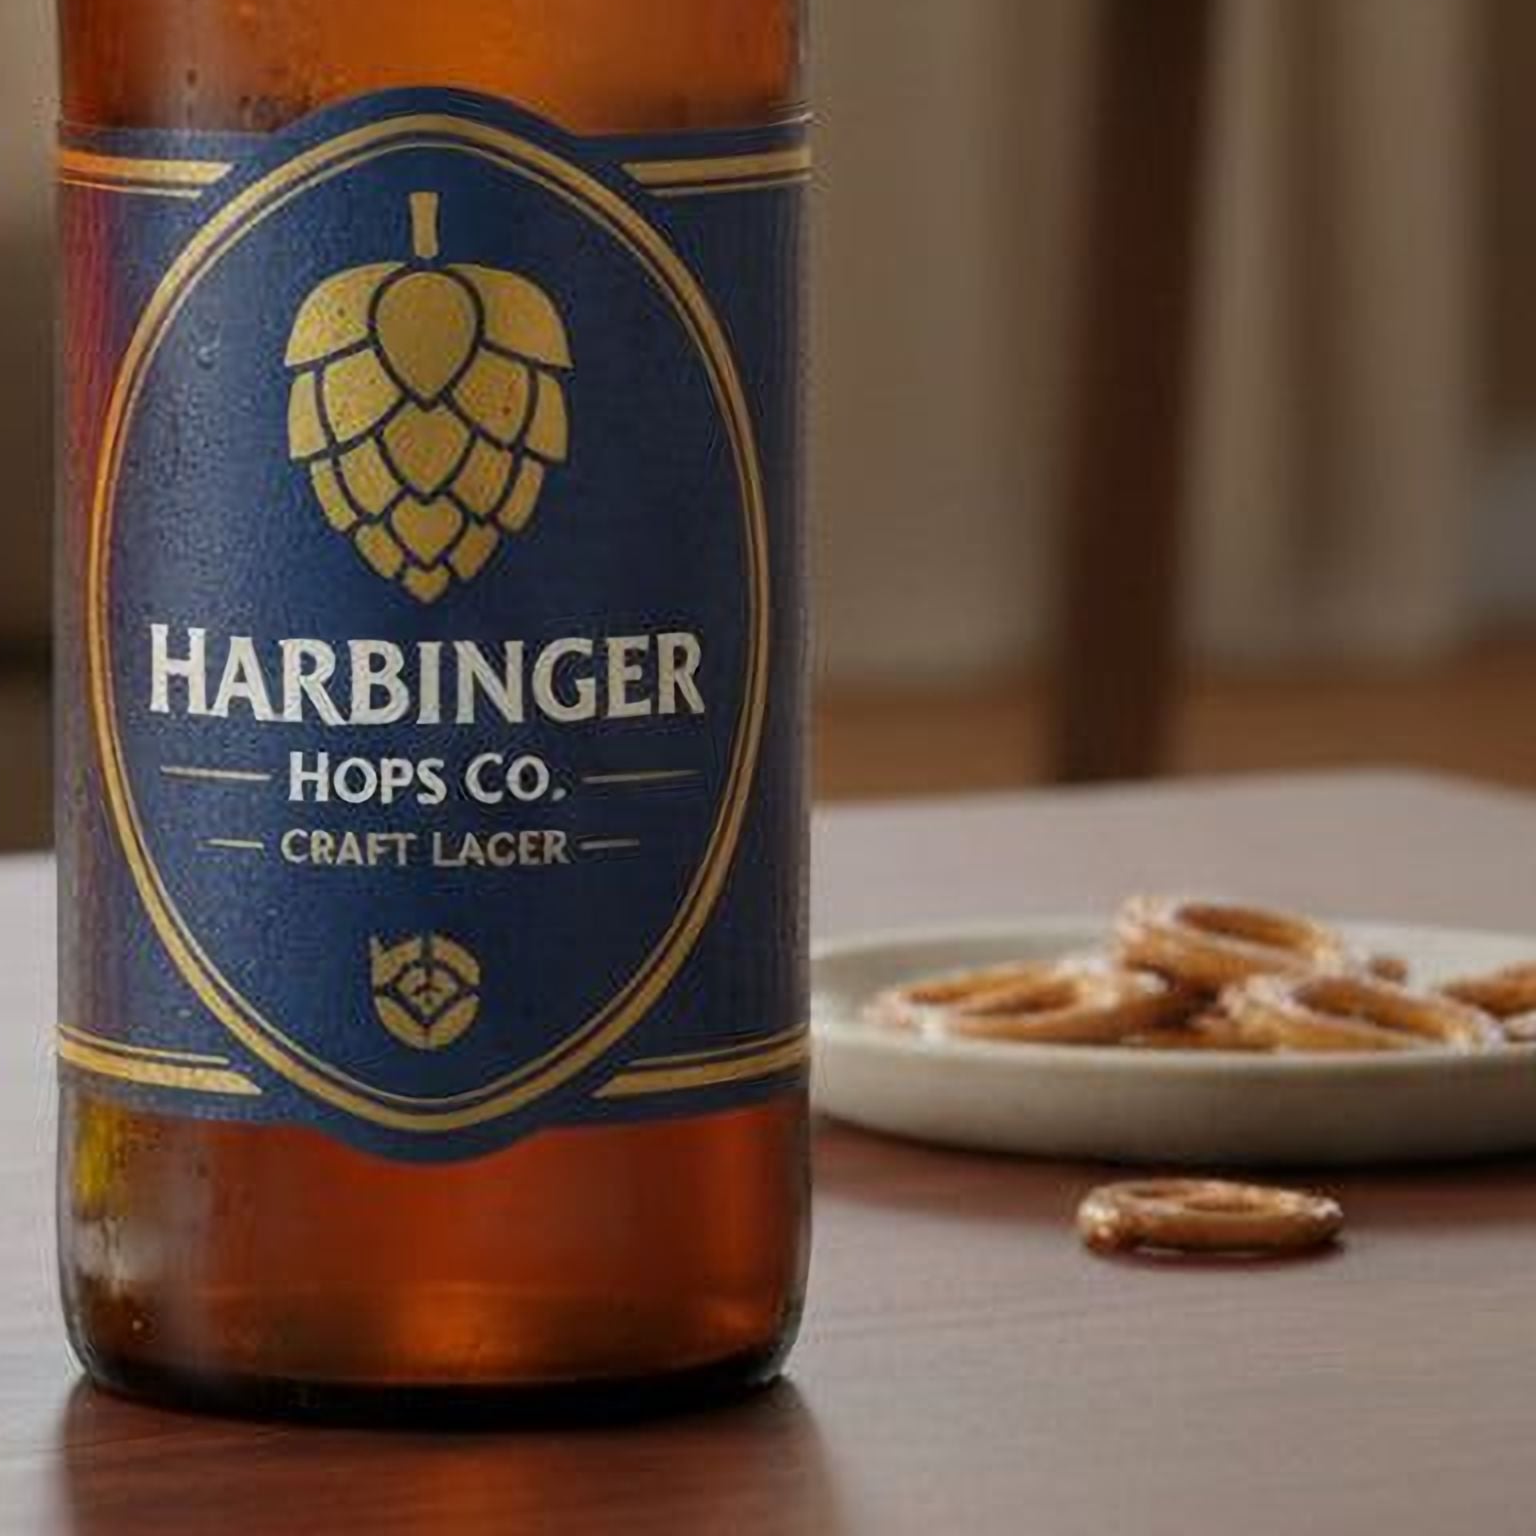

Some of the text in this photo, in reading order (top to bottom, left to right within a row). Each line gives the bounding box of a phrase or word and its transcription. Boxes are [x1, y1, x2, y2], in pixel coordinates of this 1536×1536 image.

[149, 623, 705, 725] HARBINGER
[287, 751, 567, 805] HOPS CO.
[280, 828, 417, 866] CRAFT
